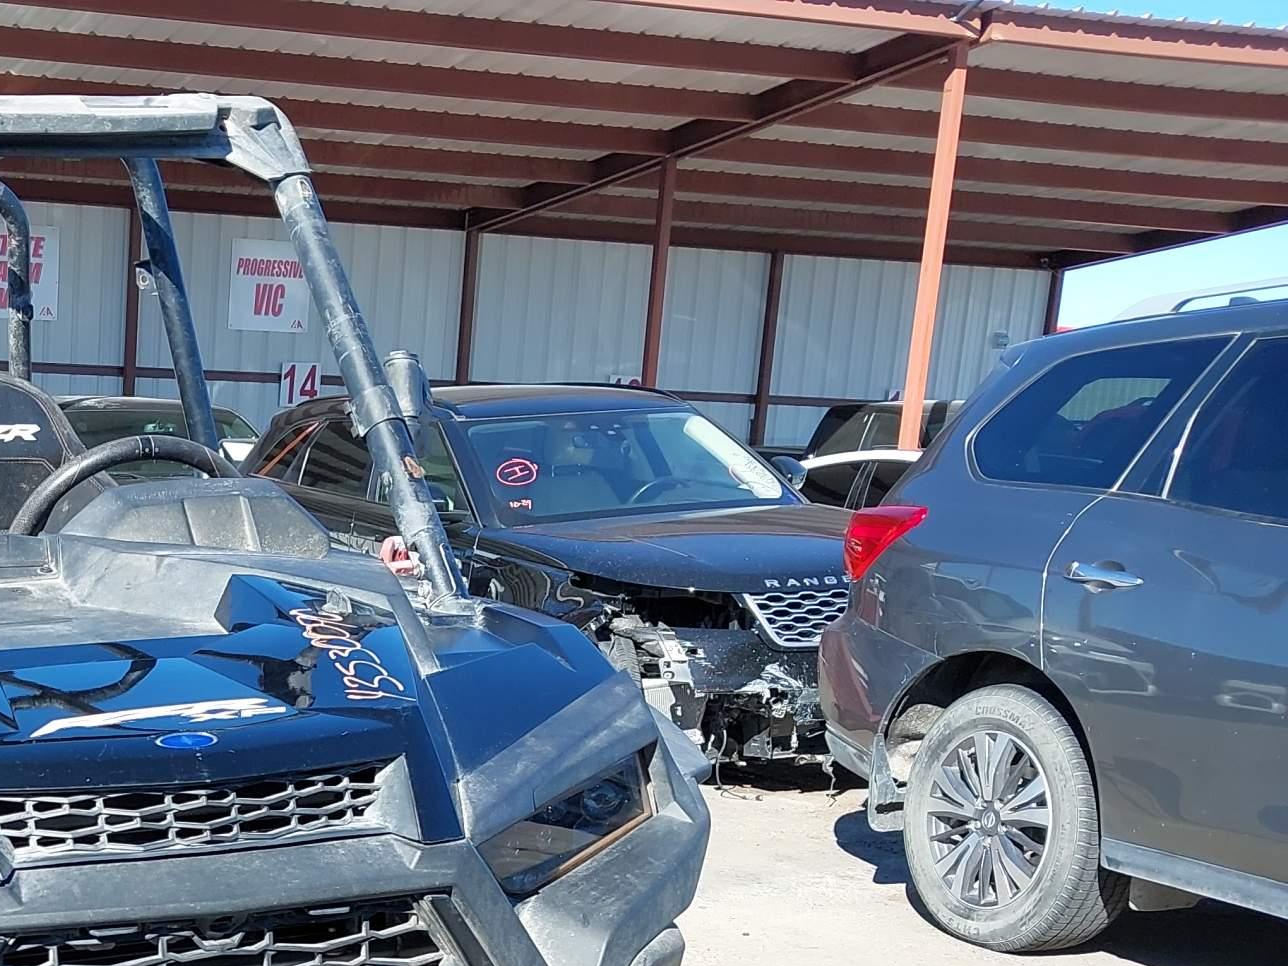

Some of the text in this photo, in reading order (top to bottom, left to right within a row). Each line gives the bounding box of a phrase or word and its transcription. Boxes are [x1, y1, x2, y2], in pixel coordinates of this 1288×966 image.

[253, 282, 286, 317] VIC
[283, 364, 318, 405] 14
[764, 575, 851, 588] RANGE
